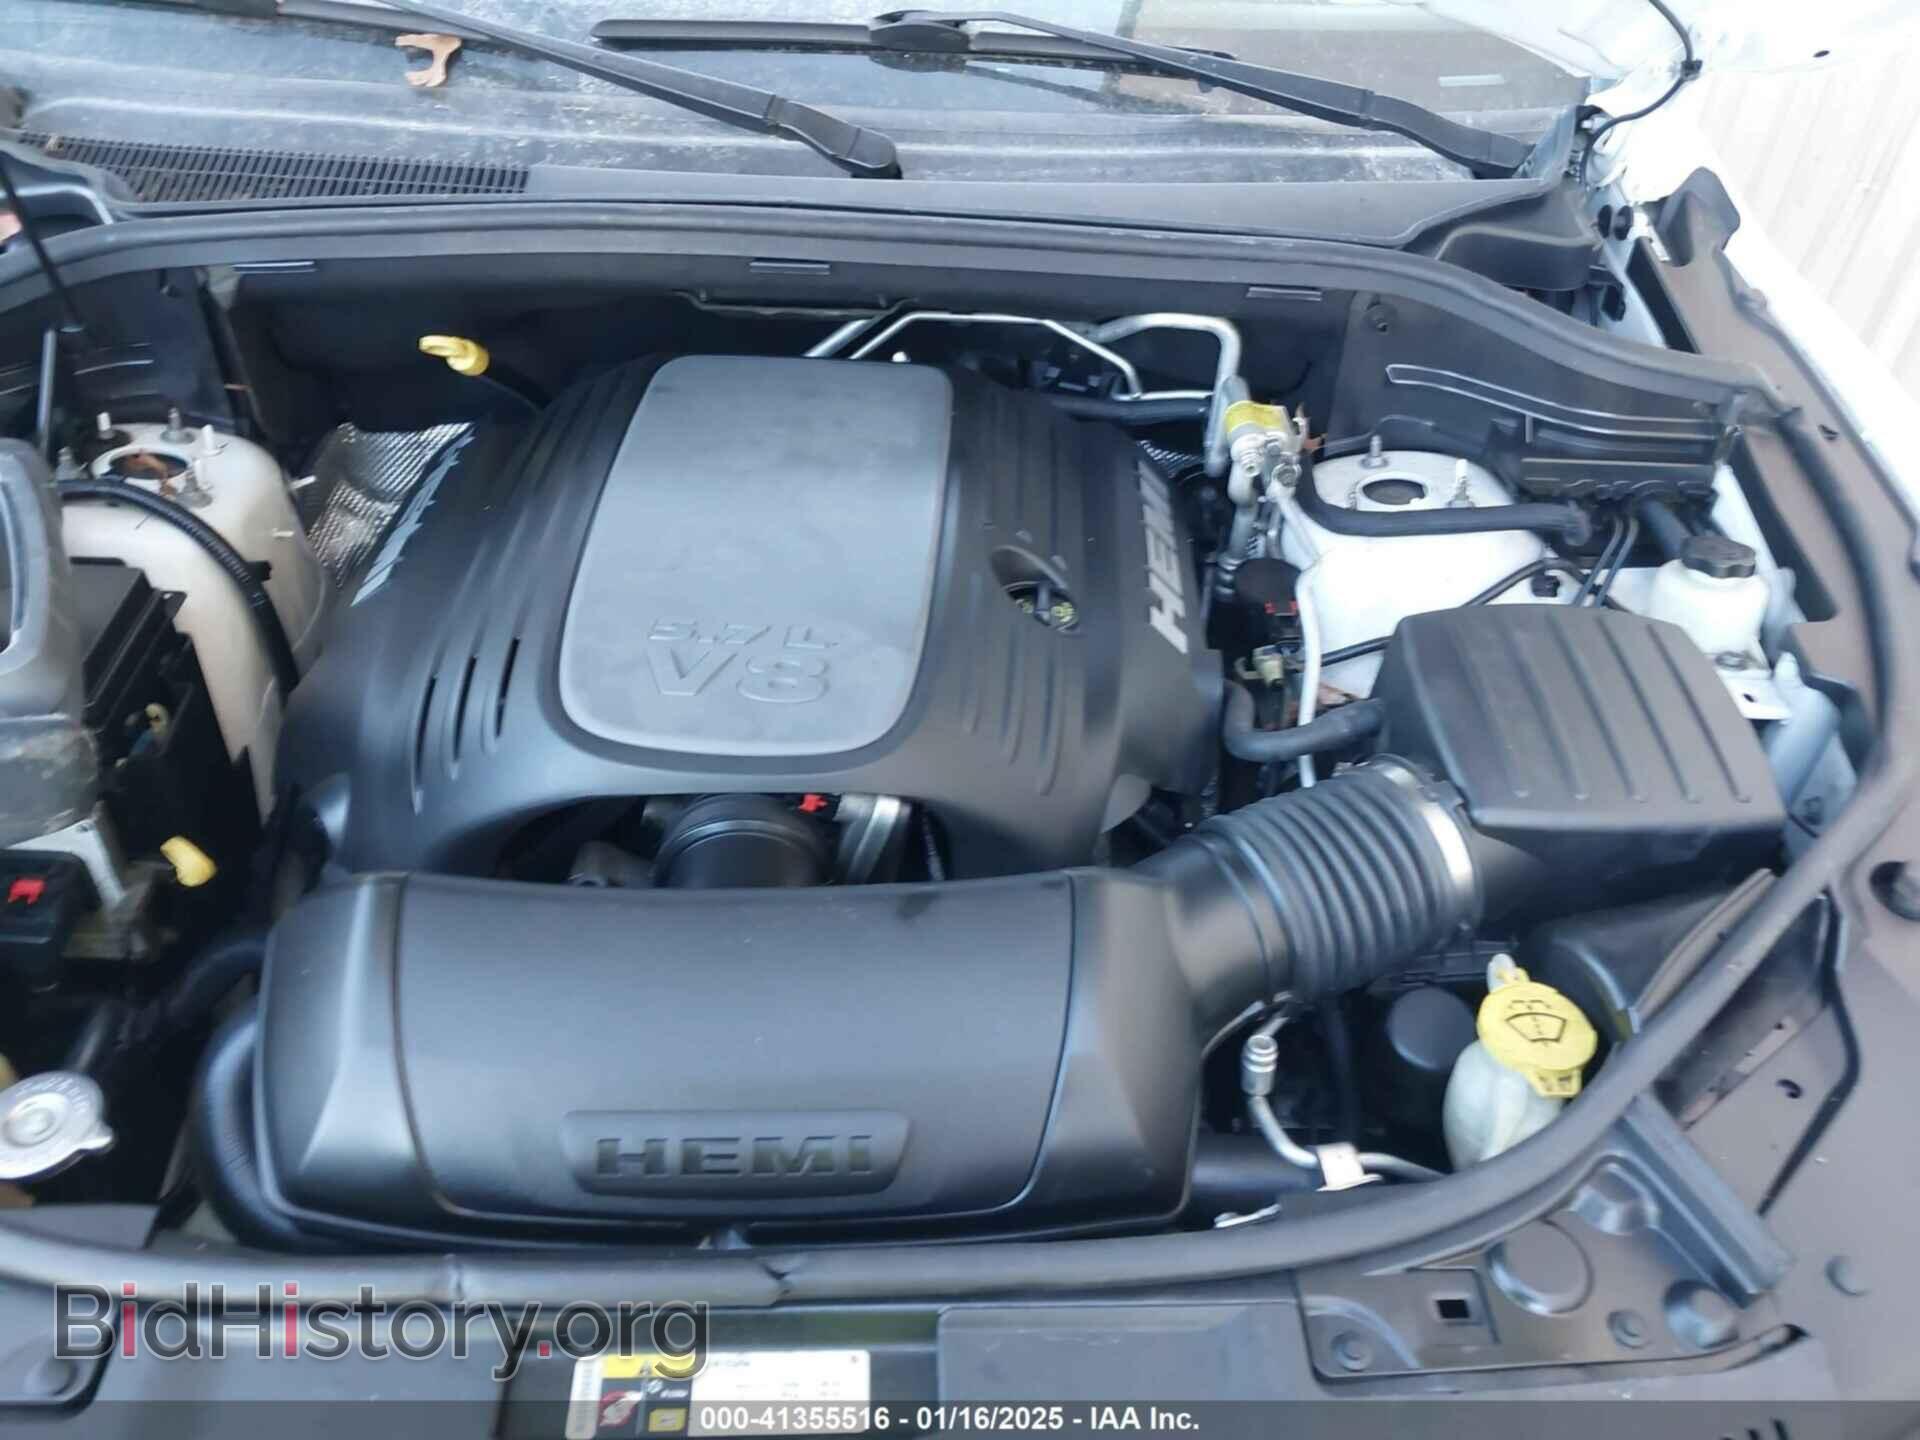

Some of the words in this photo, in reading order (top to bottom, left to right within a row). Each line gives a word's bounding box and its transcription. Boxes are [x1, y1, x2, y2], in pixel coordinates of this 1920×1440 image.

[1138, 460, 1188, 653] HEMI
[646, 648, 831, 703] V8
[594, 1136, 872, 1176] HEMI
